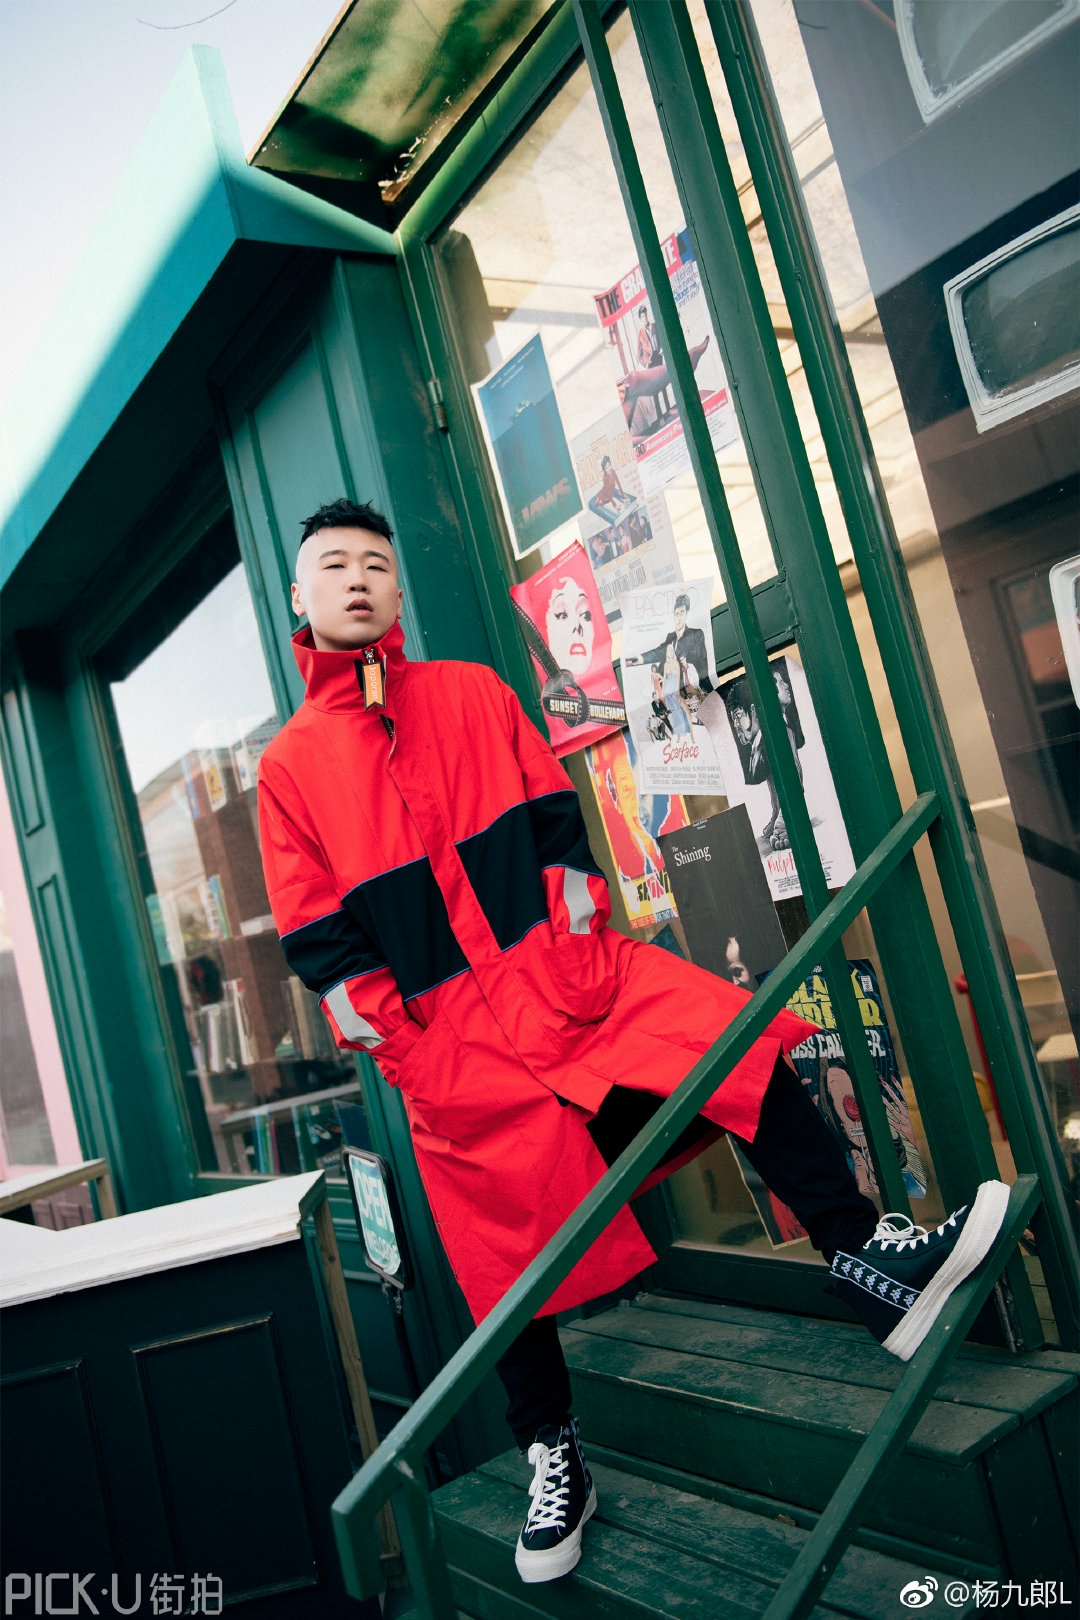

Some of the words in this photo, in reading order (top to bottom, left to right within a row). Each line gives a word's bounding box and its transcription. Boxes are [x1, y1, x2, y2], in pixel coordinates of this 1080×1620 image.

[596, 287, 622, 319] THE
[549, 699, 579, 715] SUNSET
[589, 704, 626, 721] BOULEVARD
[662, 740, 700, 765] Scarface
[674, 846, 712, 867] Shining
[353, 1168, 395, 1236] OPEN
